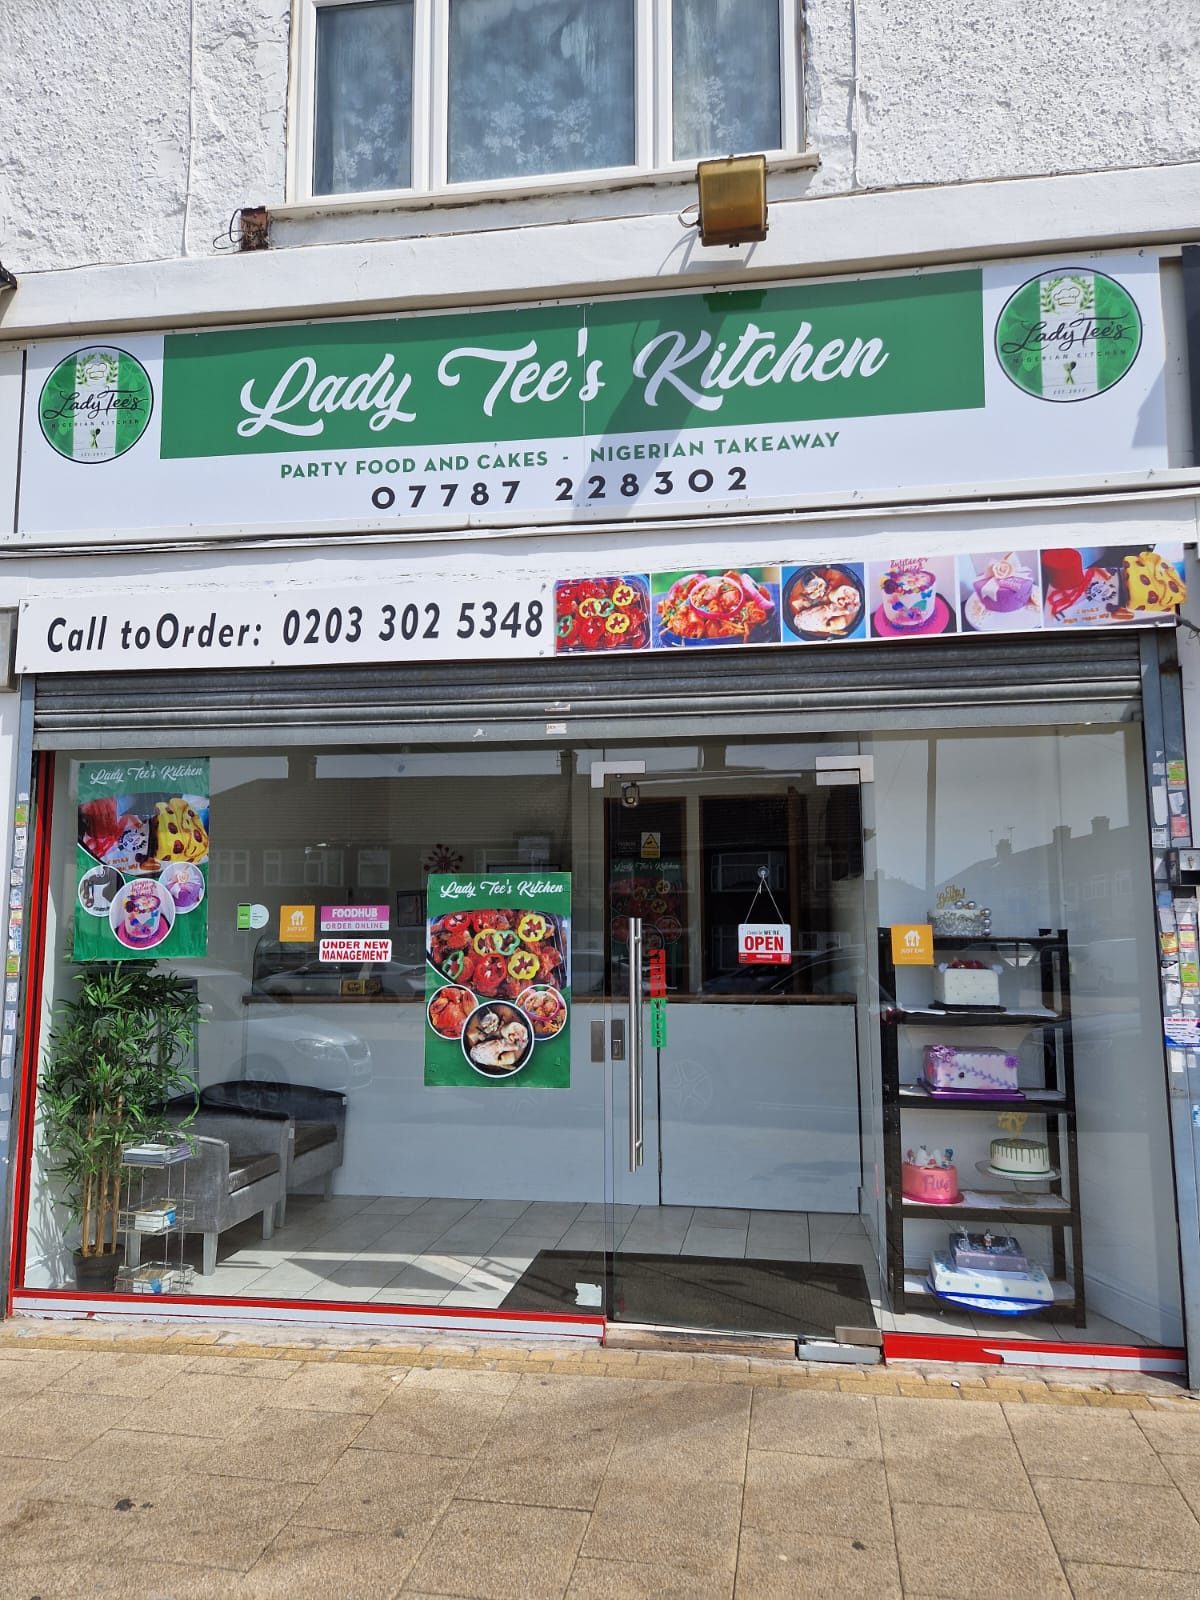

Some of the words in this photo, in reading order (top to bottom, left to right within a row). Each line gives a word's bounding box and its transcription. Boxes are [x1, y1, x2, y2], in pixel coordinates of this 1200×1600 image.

[1002, 319, 1074, 353] Lady
[237, 353, 417, 437] Lady
[437, 327, 606, 417] Tee's
[632, 321, 890, 412] Kitchen
[43, 388, 101, 420] Lady
[280, 461, 348, 479] PARTY
[355, 458, 416, 475] FOOD
[423, 454, 470, 472] AND
[476, 451, 549, 470] CAKES
[590, 440, 704, 463] NIGERIAN
[714, 431, 841, 455] TAKEAWAY
[371, 480, 521, 510] 07787
[554, 466, 748, 501] 228302
[47, 615, 108, 653] Call
[282, 605, 364, 646] 0203
[378, 602, 441, 641] 302
[456, 599, 544, 640] 5348
[90, 768, 124, 785] Lady
[160, 764, 203, 781] Kitchen
[440, 881, 477, 899] Lady
[479, 879, 512, 896] Tee's
[516, 880, 564, 898] Kitchen
[331, 907, 378, 918] FOODHUB
[325, 922, 352, 930] ORDER
[322, 940, 361, 949] UNDER
[363, 940, 389, 949] NEW
[744, 935, 784, 951] OPEN
[322, 950, 389, 961] MANAGEMENT
